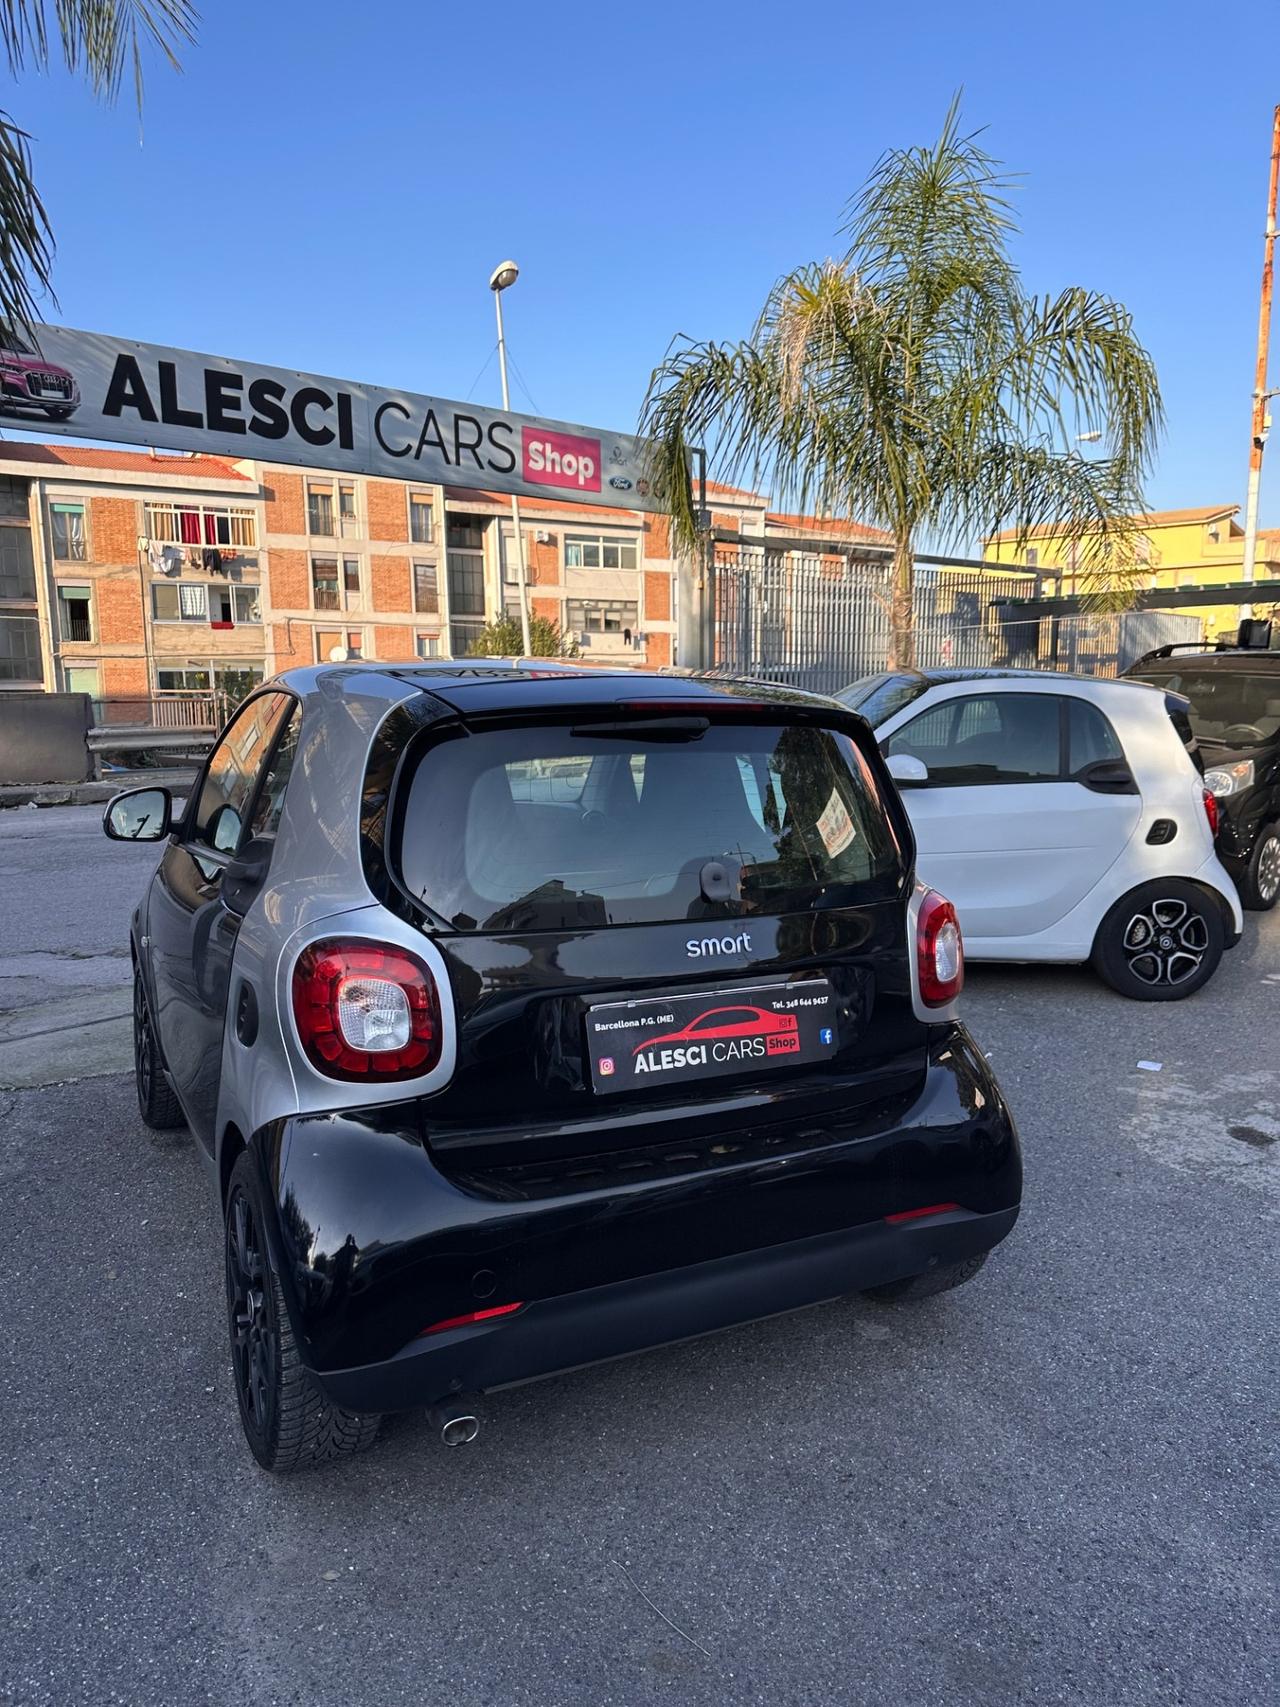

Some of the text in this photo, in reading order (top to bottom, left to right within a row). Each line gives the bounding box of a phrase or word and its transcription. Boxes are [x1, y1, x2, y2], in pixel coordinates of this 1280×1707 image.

[102, 353, 595, 486] ALESCI CARS Shop
[686, 932, 753, 958] smart
[786, 999, 798, 1008] 348
[800, 998, 812, 1006] 644
[595, 1014, 675, 1032] Barcellona P.G. (ME)
[634, 1038, 796, 1074] ALESCI CARS Shop
